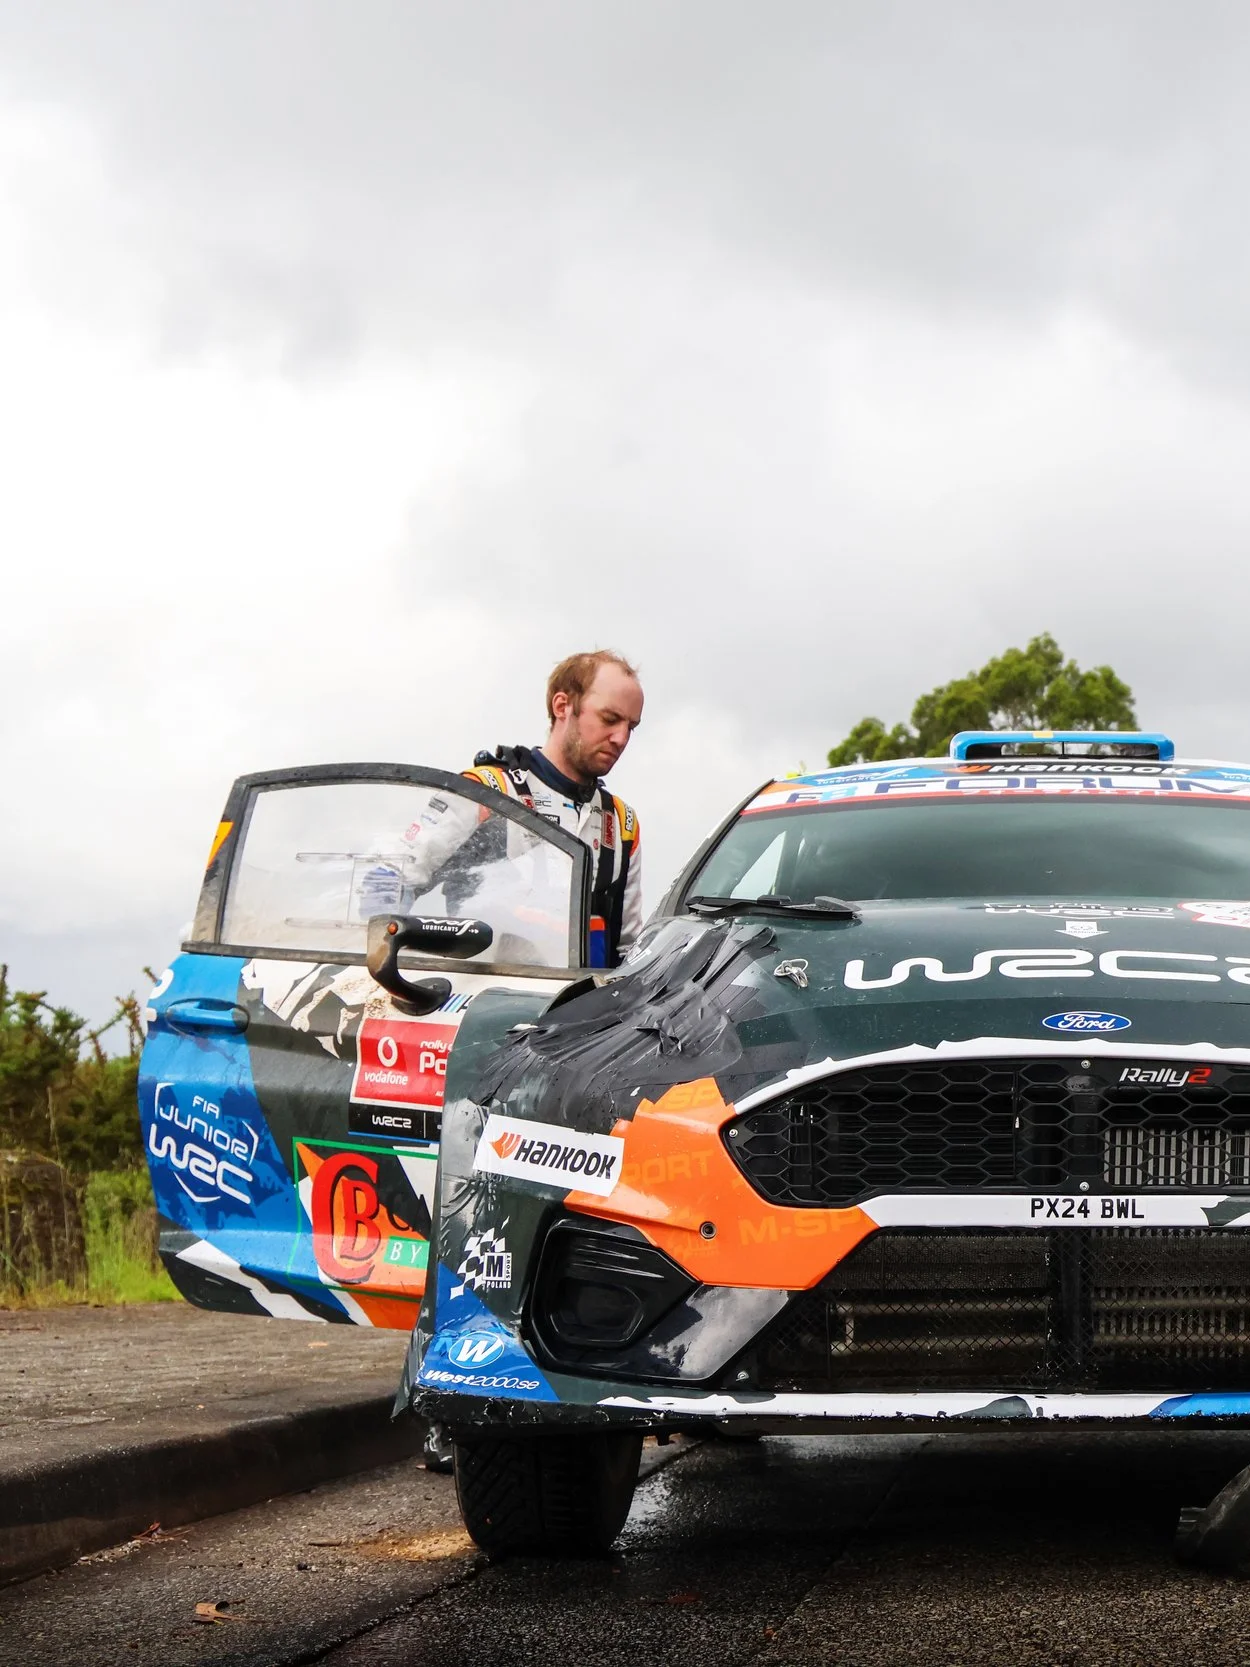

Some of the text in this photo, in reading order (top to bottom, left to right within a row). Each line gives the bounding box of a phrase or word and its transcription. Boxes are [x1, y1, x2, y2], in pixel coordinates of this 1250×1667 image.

[988, 764, 1190, 776] HANKOOK
[422, 924, 459, 933] LUBRICANTS
[1058, 1012, 1115, 1031] Ford
[420, 1040, 448, 1053] rally
[364, 1070, 409, 1086] vodafone
[1119, 1066, 1212, 1087] Rally2
[192, 1095, 221, 1120] FIA
[372, 1113, 412, 1129] WRC2
[159, 1105, 249, 1162] JUNIOR
[149, 1122, 253, 1205] WRC
[513, 1138, 616, 1181] HANKOOK
[1030, 1198, 1145, 1219] PX24 BWL
[485, 1255, 503, 1278] M
[486, 1280, 512, 1289] POLAND
[455, 1338, 503, 1363] W
[424, 1369, 540, 1390] West2000.se
